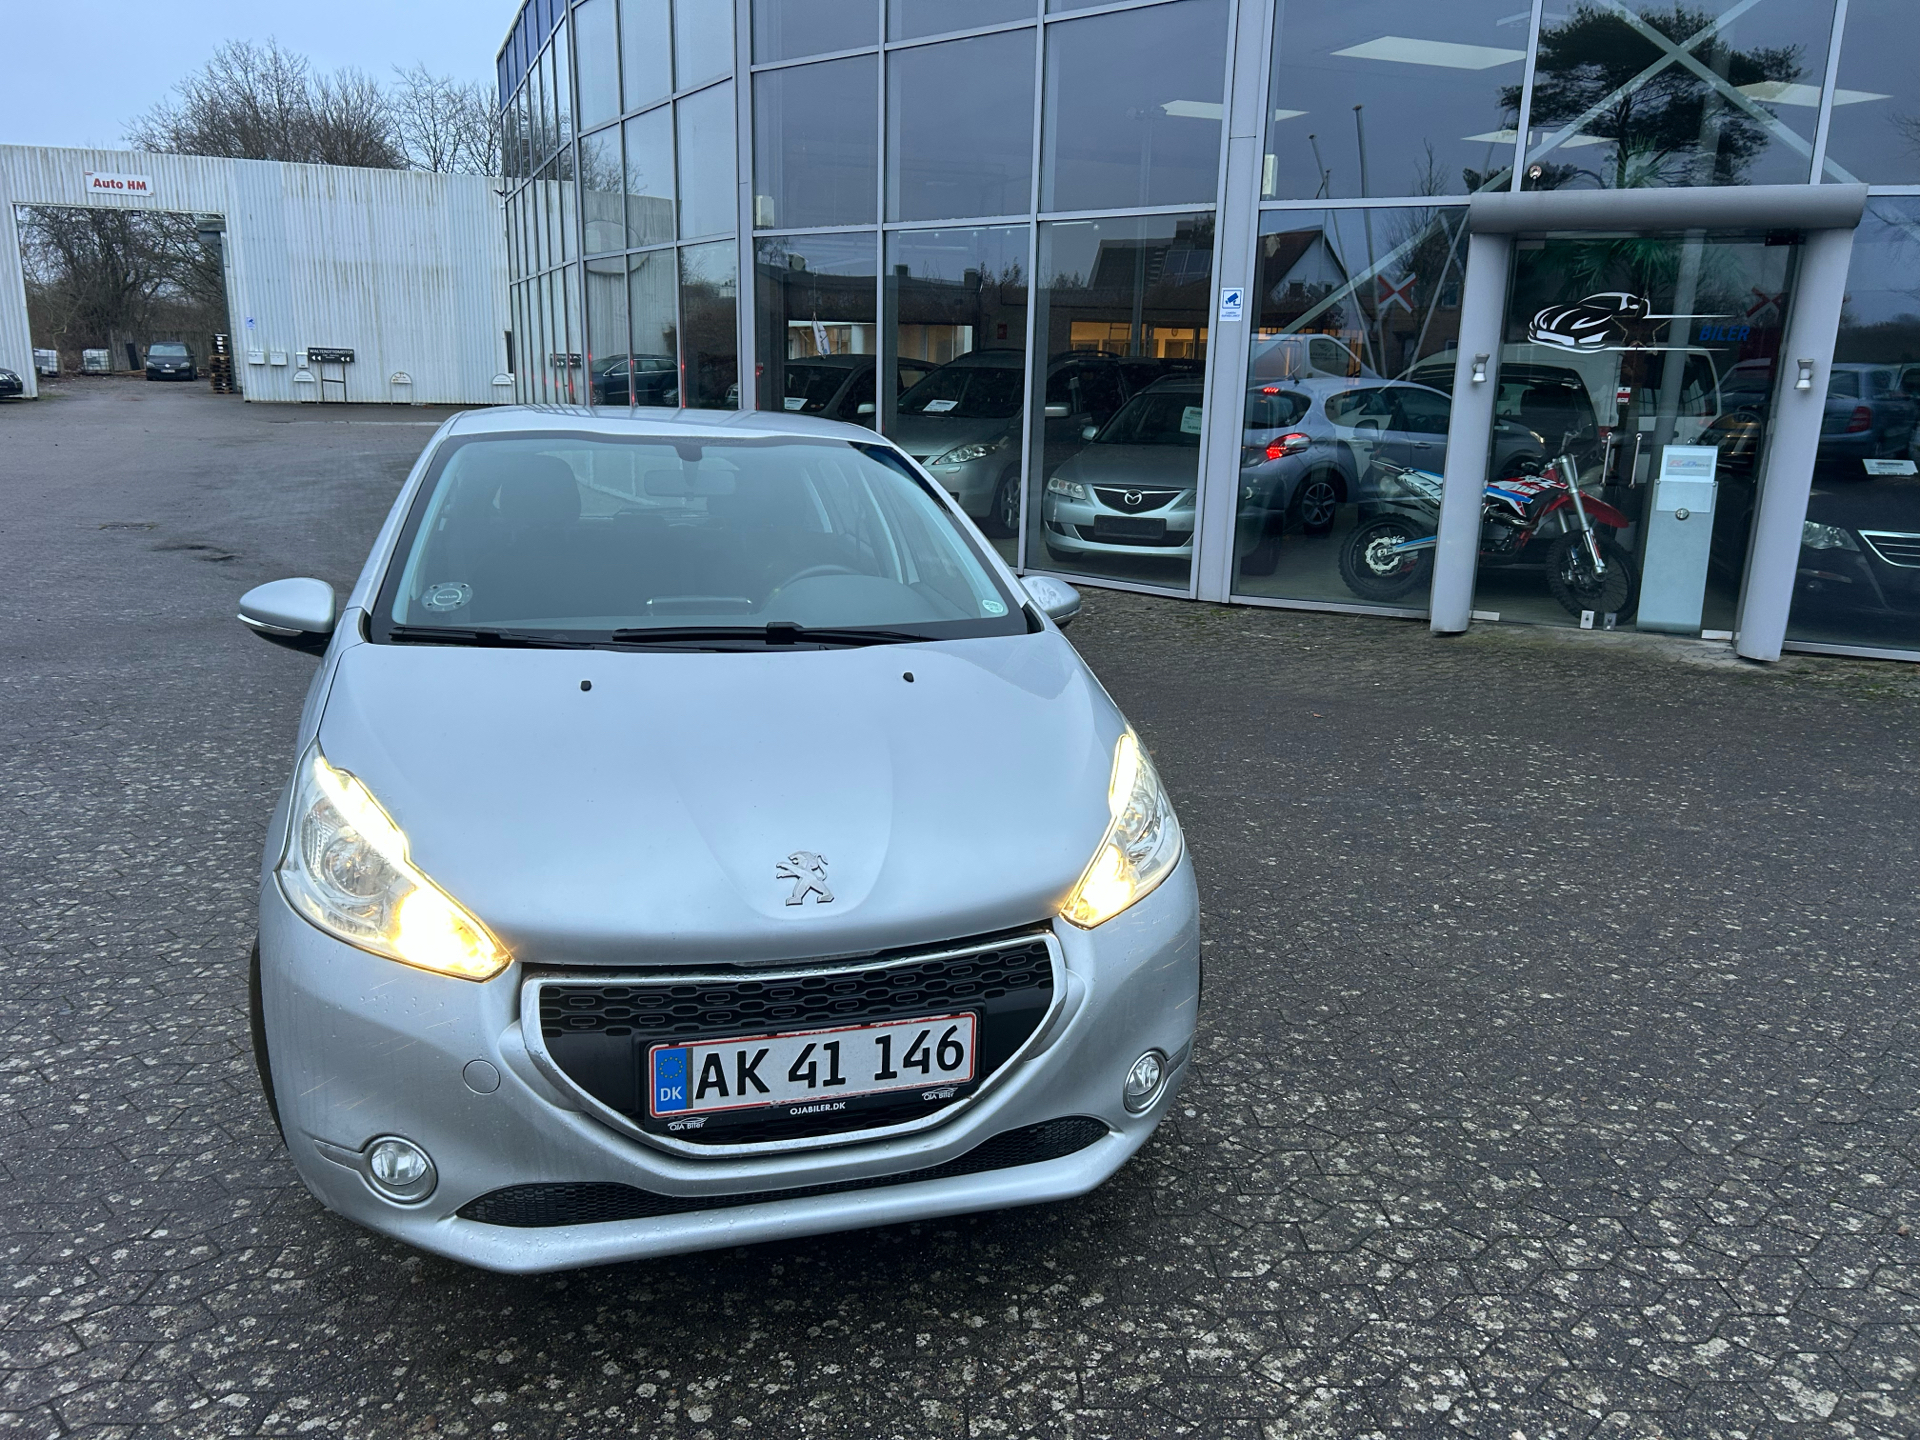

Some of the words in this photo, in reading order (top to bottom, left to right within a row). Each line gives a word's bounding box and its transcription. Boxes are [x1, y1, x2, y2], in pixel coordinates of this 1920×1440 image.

[93, 178, 124, 189] Auto
[127, 180, 147, 190] HM
[1699, 325, 1750, 341] BILER
[694, 1048, 770, 1100] AK
[787, 1040, 846, 1088] 41
[873, 1025, 965, 1081] 146
[660, 1086, 683, 1101] DK
[789, 1102, 846, 1115] OJABILER.DK
